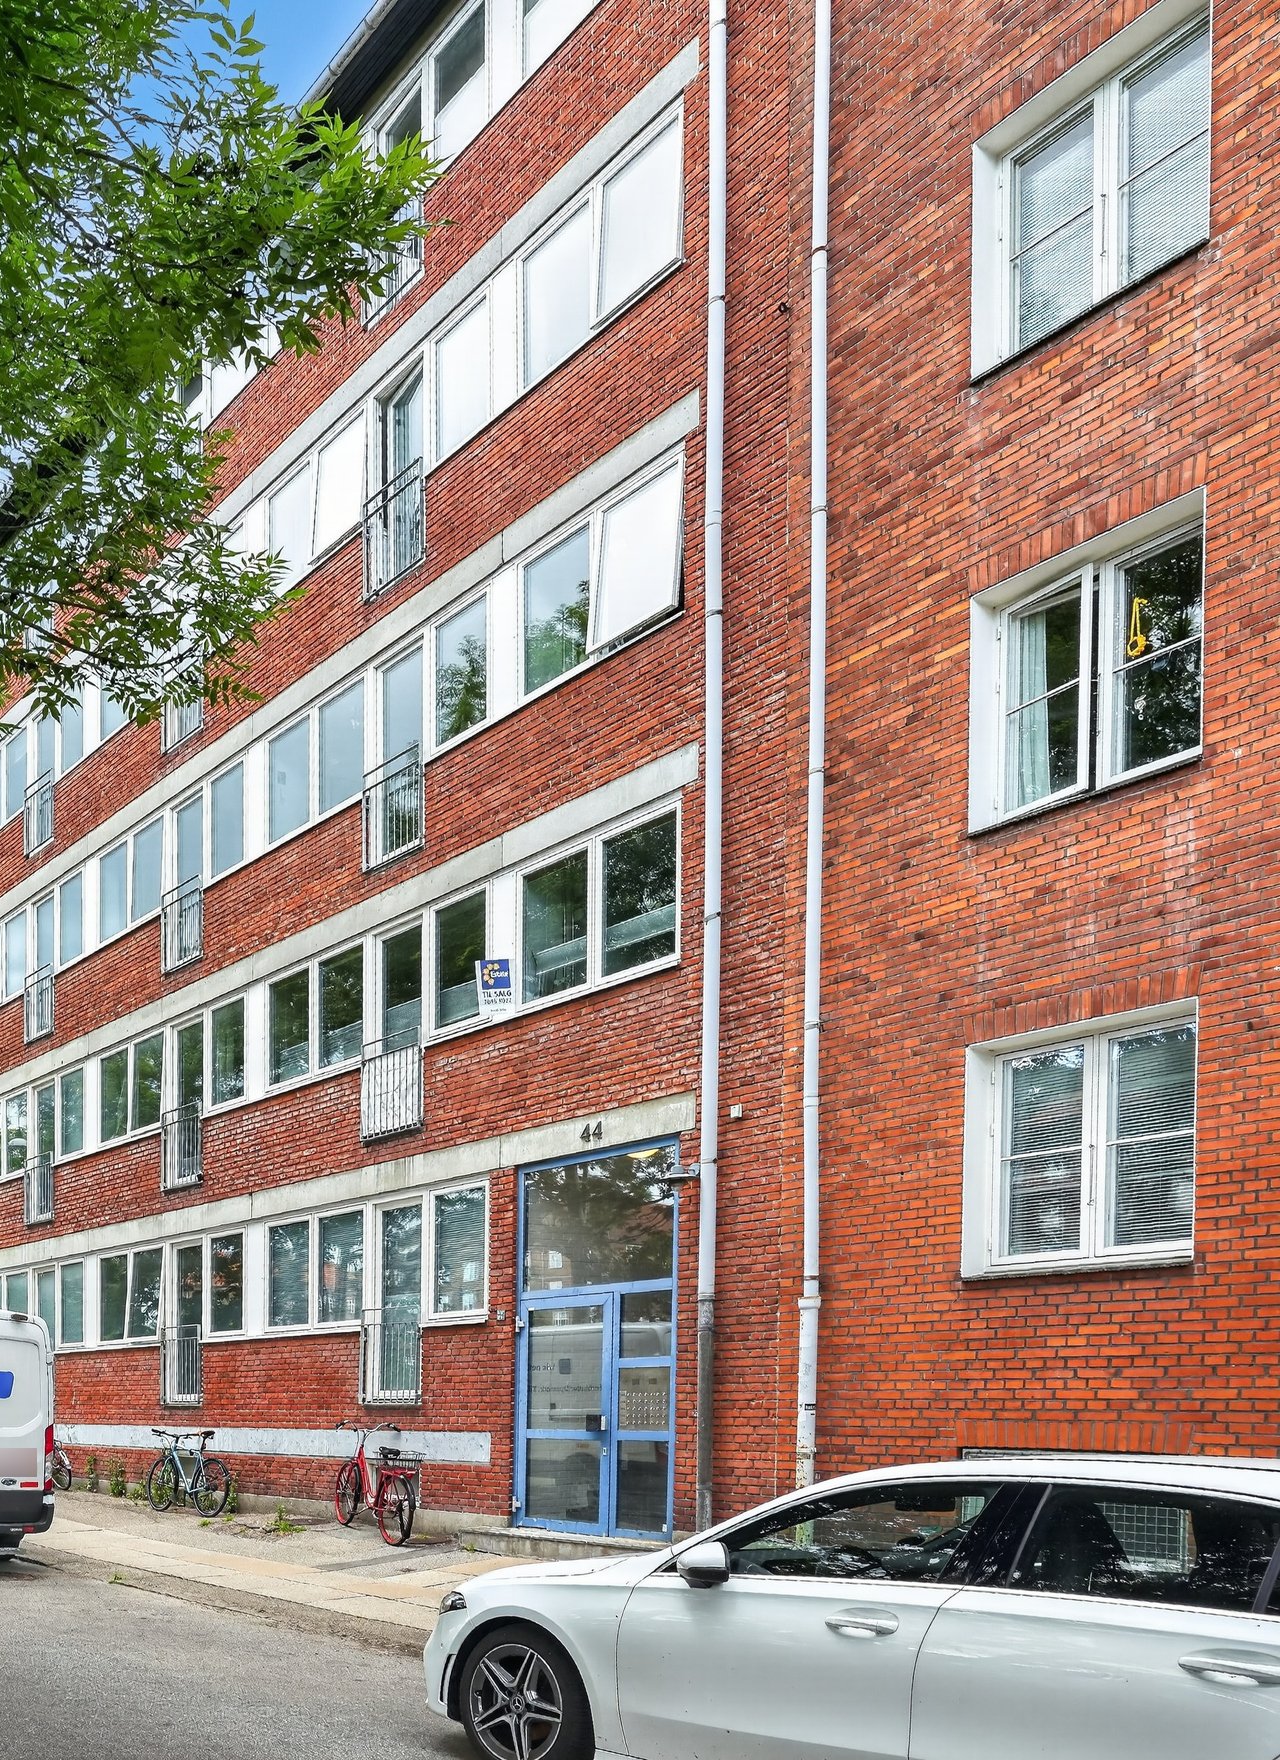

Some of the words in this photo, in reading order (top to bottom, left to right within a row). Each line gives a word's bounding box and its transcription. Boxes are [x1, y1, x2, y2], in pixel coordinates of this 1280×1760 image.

[482, 991, 492, 999] TIL
[494, 990, 512, 998] SALG
[580, 1120, 603, 1143] 44
